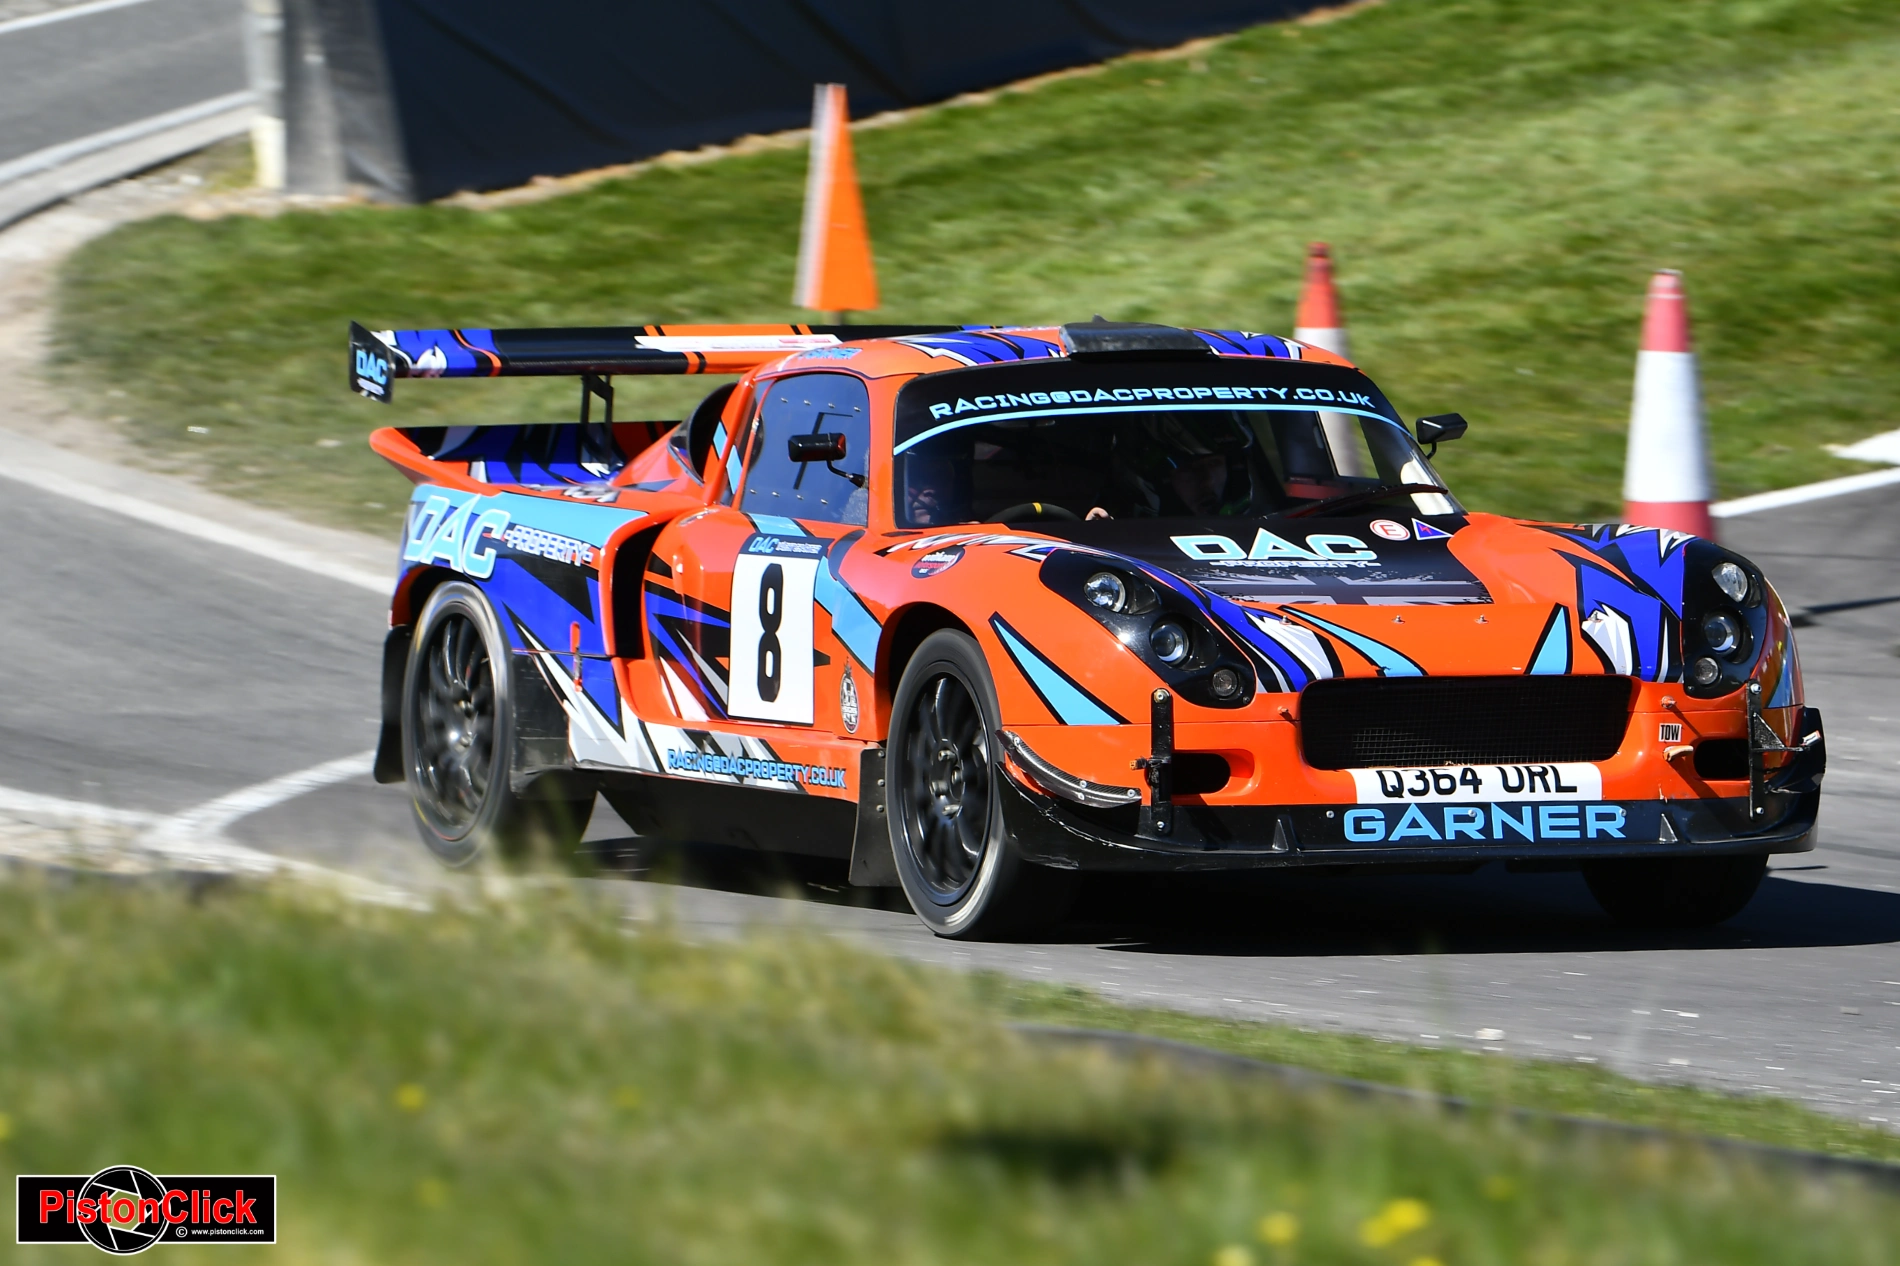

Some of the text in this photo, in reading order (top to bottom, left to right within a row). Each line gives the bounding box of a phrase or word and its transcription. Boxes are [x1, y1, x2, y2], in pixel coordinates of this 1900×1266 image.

[355, 349, 388, 386] DAC
[928, 387, 1376, 420] RACING@DACPROPERTY.CO.UK
[402, 493, 512, 579] DAC
[748, 536, 780, 554] DAC
[1169, 527, 1378, 561] DAC
[1379, 524, 1402, 537] E
[757, 563, 784, 702] 8
[1660, 724, 1680, 741] TOW
[667, 746, 848, 789] RACING@DACPROPERTY.CO.UK
[1376, 765, 1578, 799] Q364 URL
[1343, 802, 1627, 843] GARNER
